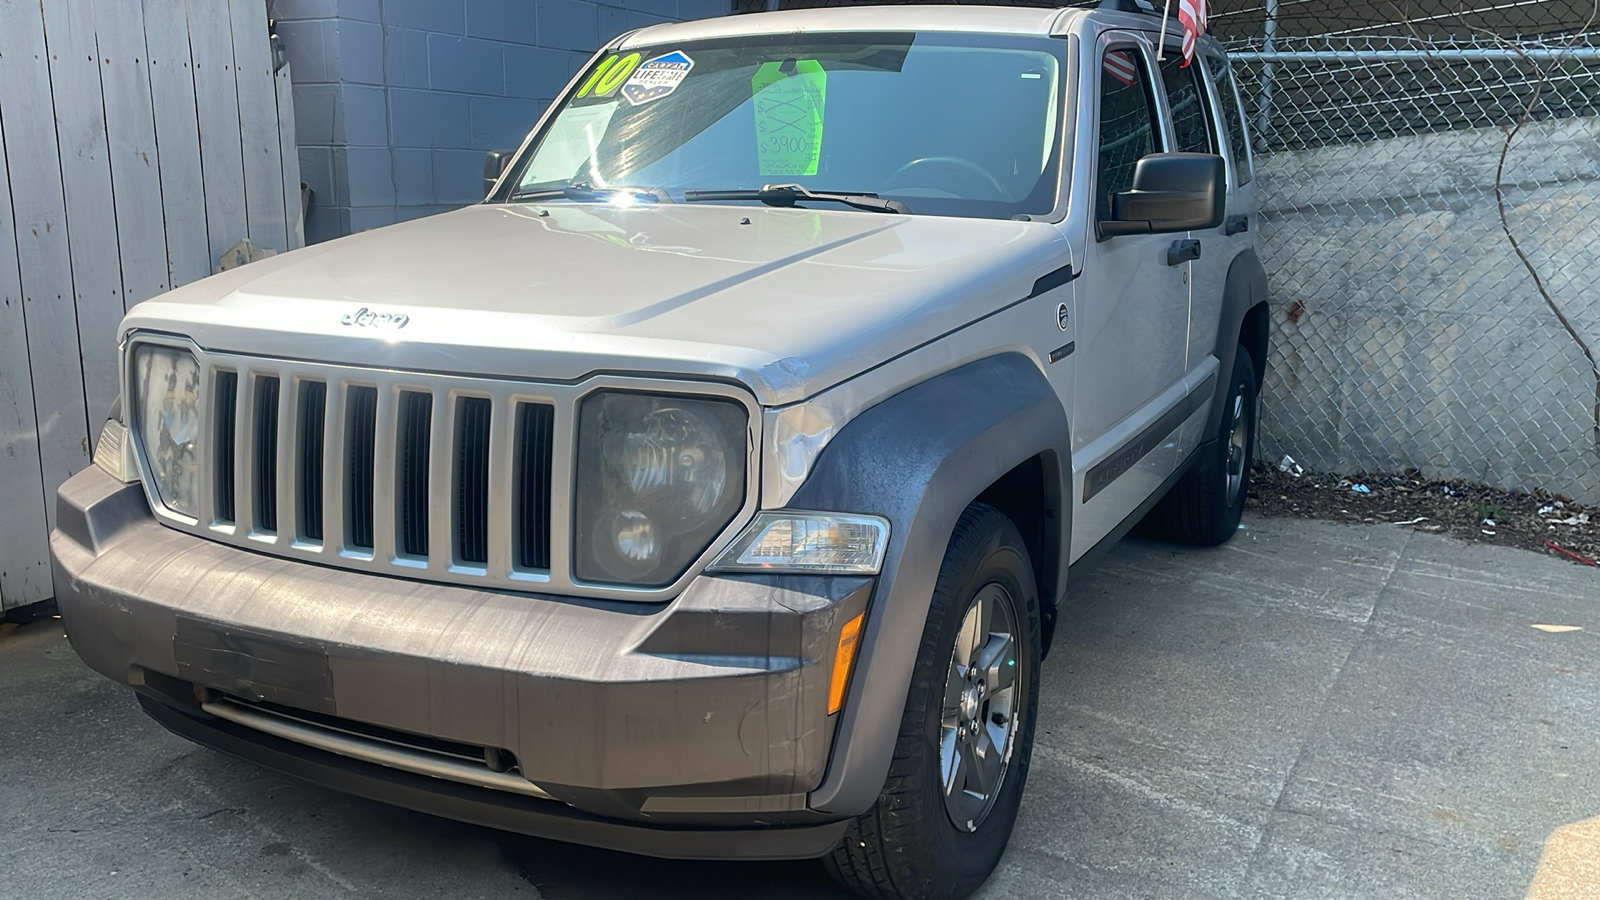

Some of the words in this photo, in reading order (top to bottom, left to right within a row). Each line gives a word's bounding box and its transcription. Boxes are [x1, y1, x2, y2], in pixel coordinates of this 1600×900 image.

[577, 53, 641, 98] 10
[633, 70, 685, 81] LIFETIME
[770, 135, 806, 153] 3900
